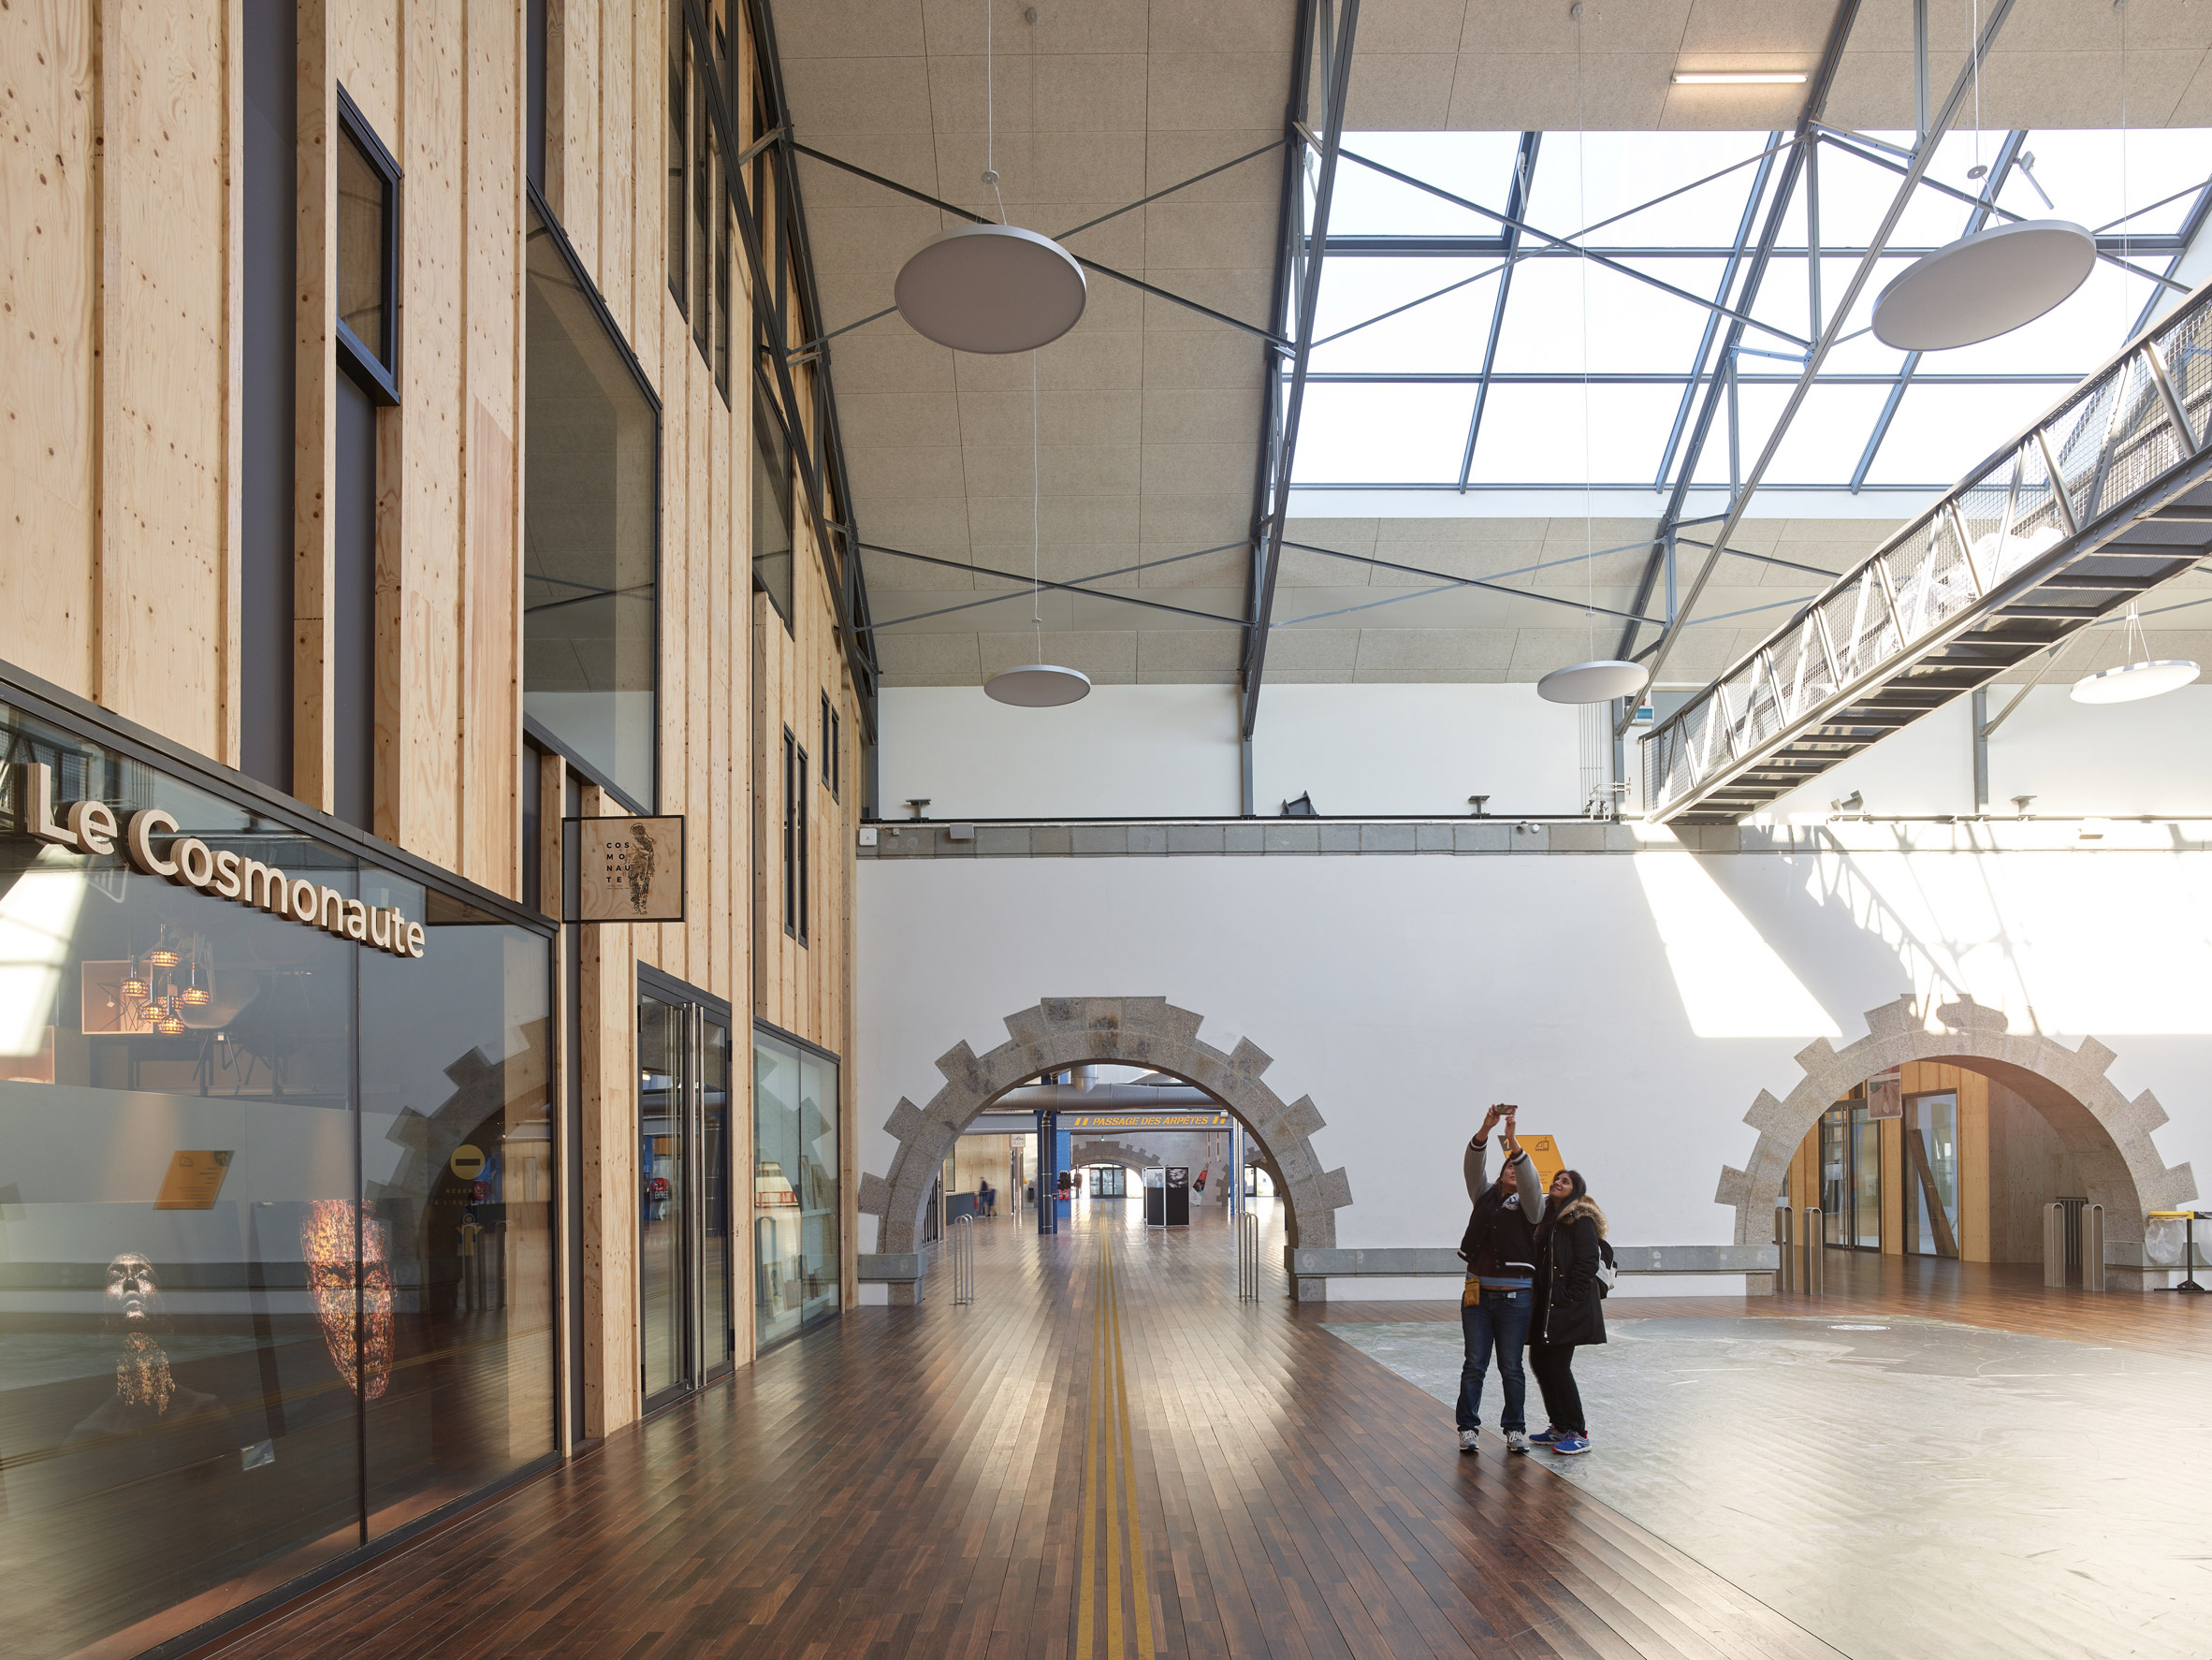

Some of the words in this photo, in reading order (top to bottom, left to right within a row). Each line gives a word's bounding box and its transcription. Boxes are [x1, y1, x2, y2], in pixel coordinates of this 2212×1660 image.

[27, 763, 117, 855] Le
[128, 809, 425, 958] Cosmonaute
[1092, 1116, 1140, 1126] PASSAGE
[1141, 1116, 1161, 1126] DES
[1163, 1114, 1209, 1126] ARPÈTES
[1504, 1138, 1510, 1149] 1
